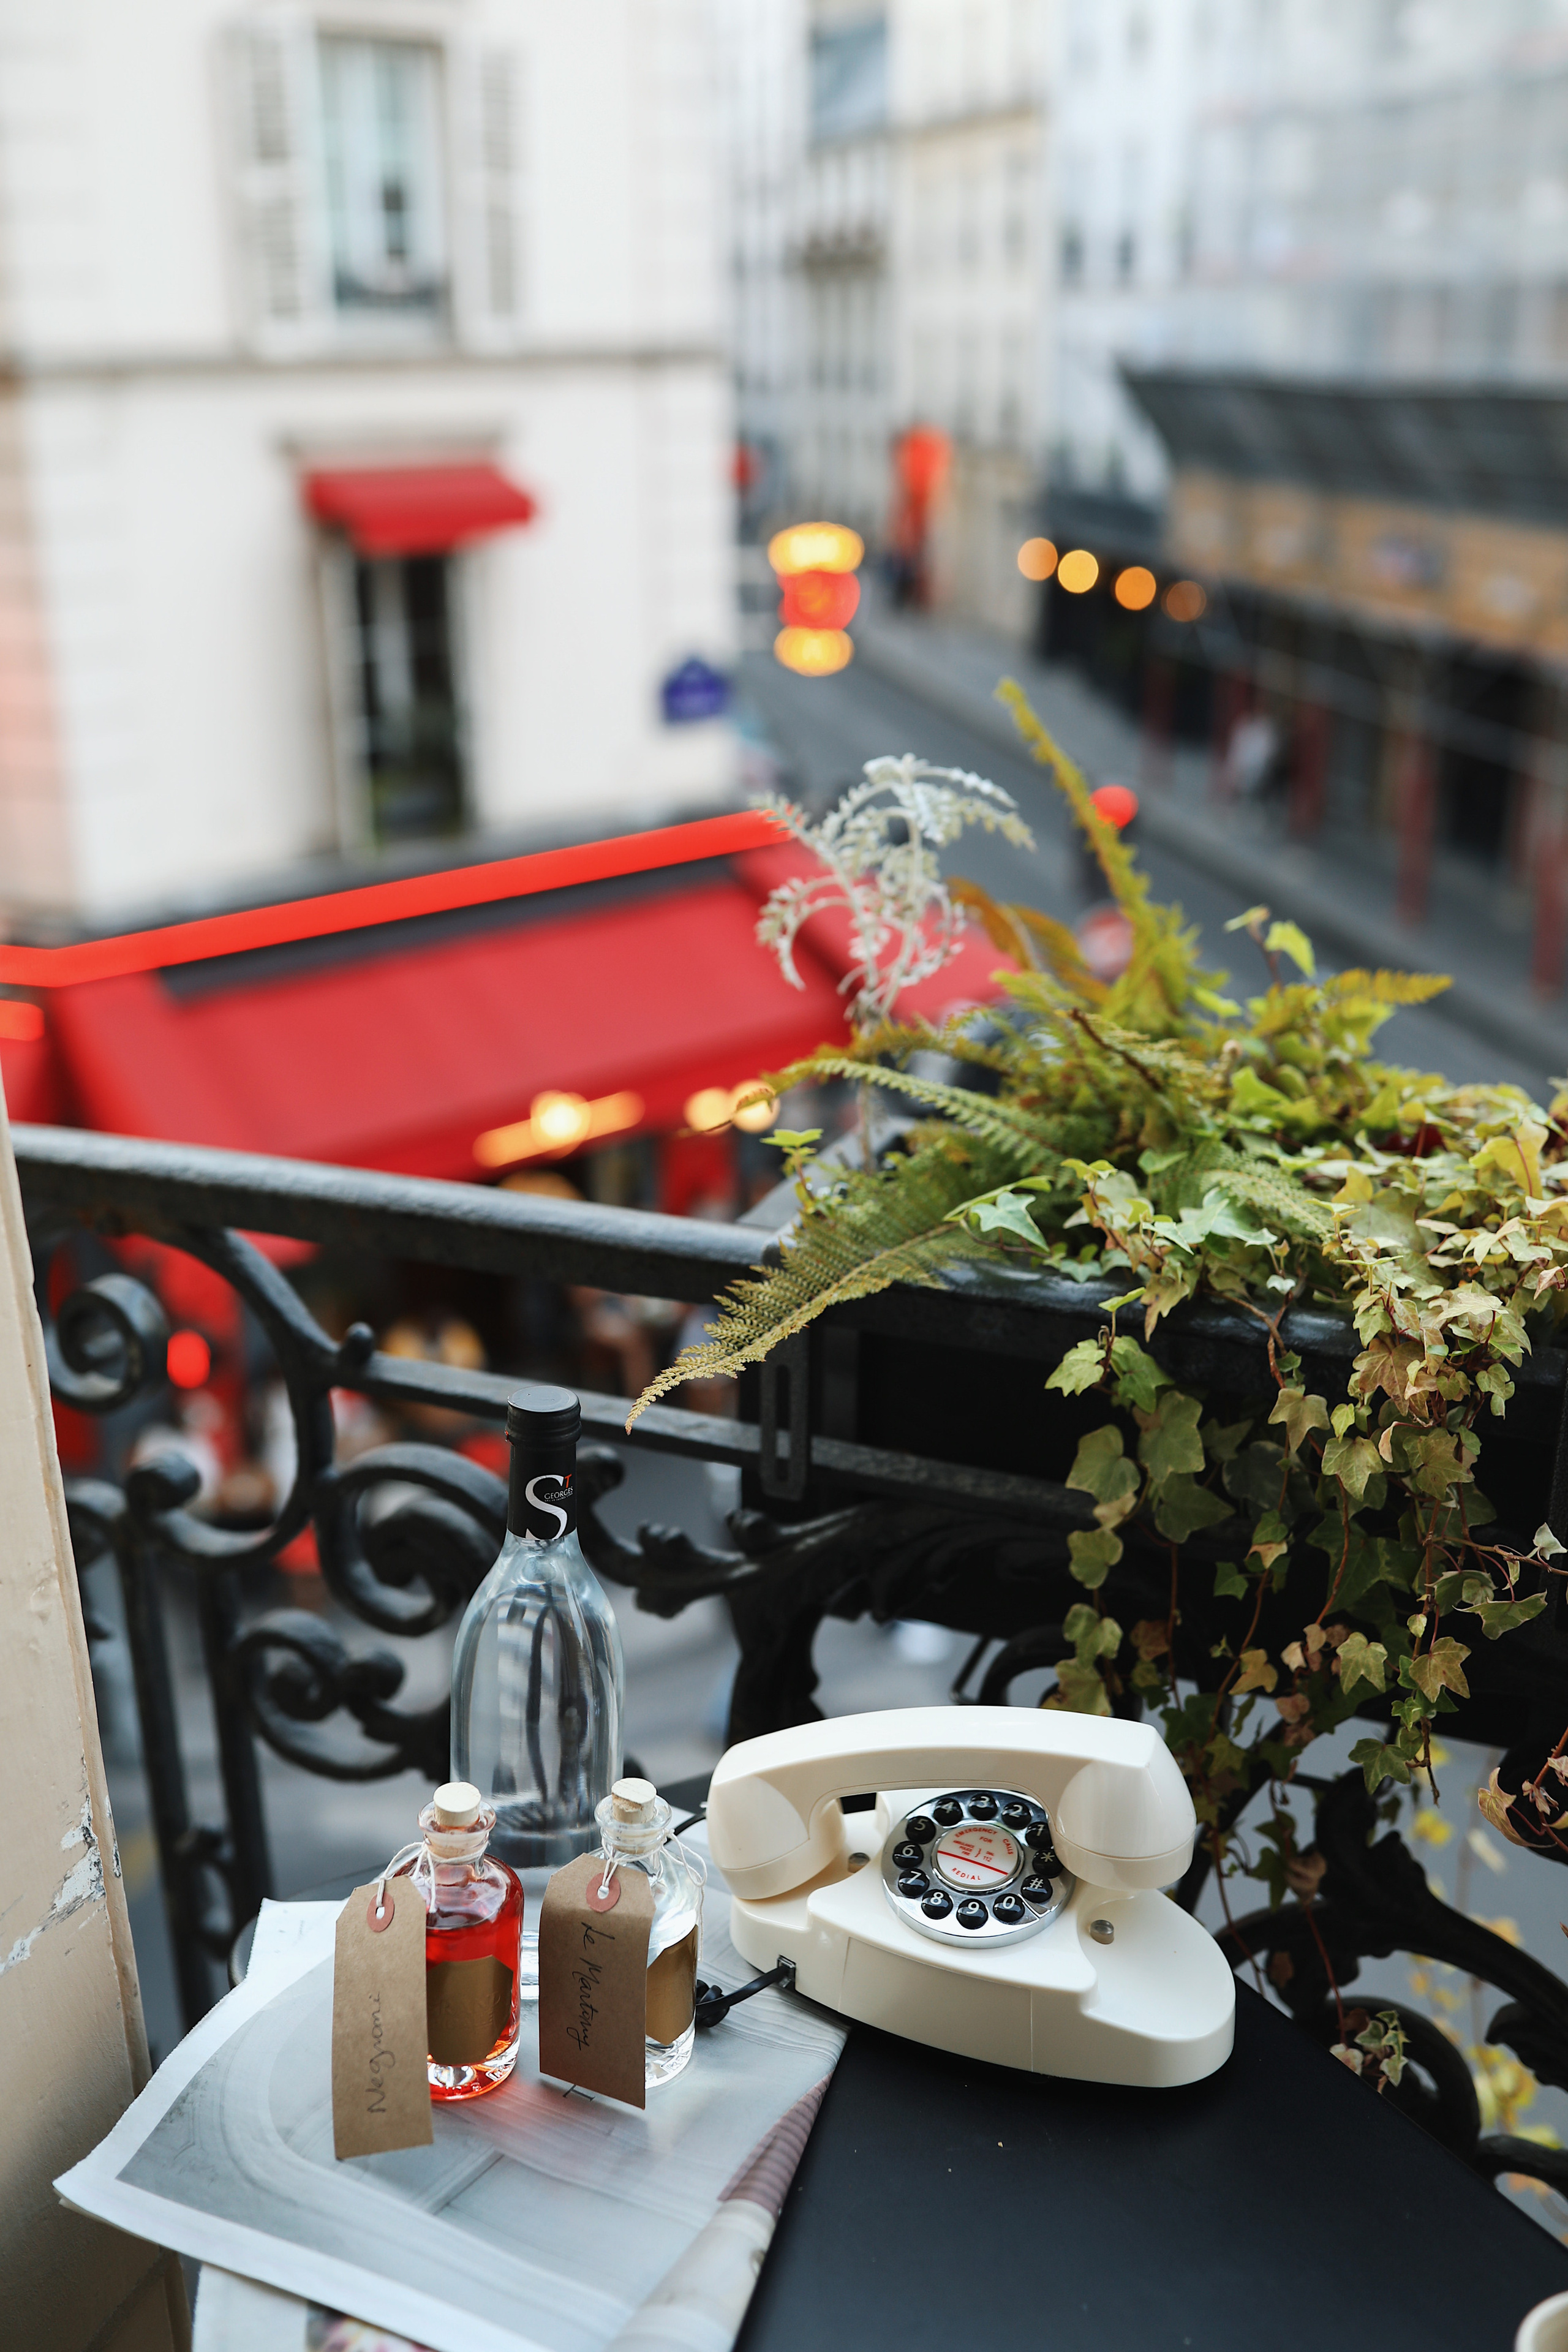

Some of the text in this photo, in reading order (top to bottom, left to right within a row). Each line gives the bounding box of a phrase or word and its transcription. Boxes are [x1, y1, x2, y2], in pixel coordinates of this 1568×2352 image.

[544, 1487, 573, 1499] GEORGES
[941, 1802, 954, 1814] 4
[976, 1796, 990, 1808] 3
[1009, 1804, 1023, 1817] 2
[914, 1819, 929, 1831] 5
[1036, 1824, 1045, 1836] 1
[954, 1827, 1014, 1855] EMERGENCY CALLS
[902, 1845, 916, 1856] 6
[907, 1871, 922, 1884] 7
[951, 1867, 981, 1880] REDIAL
[930, 1891, 944, 1905] 8
[1003, 1896, 1016, 1909] 0
[966, 1901, 980, 1914] 9
